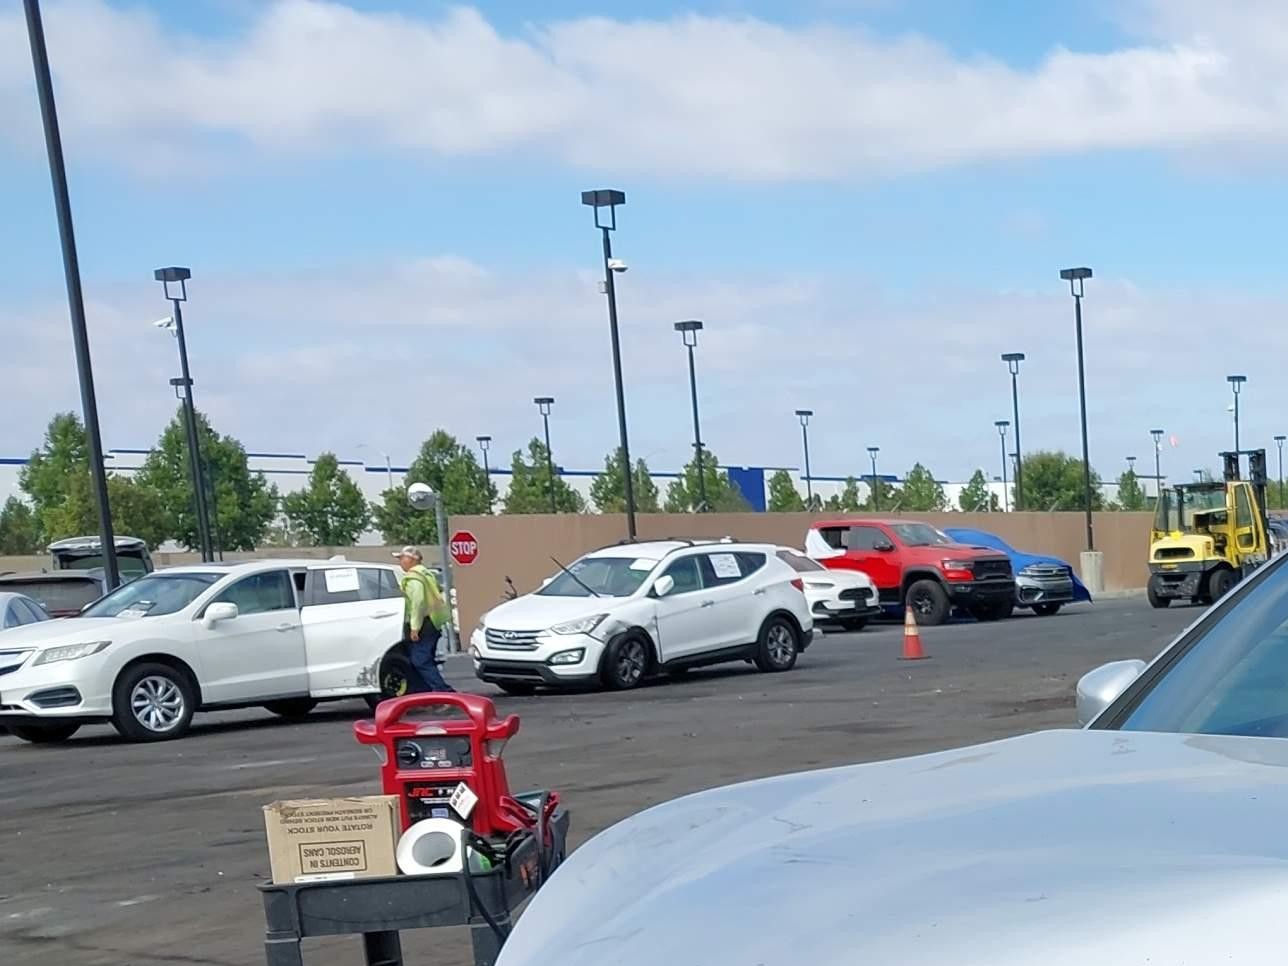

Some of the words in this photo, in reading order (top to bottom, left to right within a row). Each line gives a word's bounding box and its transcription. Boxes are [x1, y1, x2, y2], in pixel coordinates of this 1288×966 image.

[451, 541, 477, 555] STOP
[287, 826, 315, 835] STOCK
[316, 825, 341, 833] YOUR
[341, 823, 374, 832] ROTATE
[303, 847, 325, 858] CANS
[326, 845, 362, 857] AEROSOL
[310, 860, 319, 869] IN
[319, 857, 360, 868] CONTENTS
